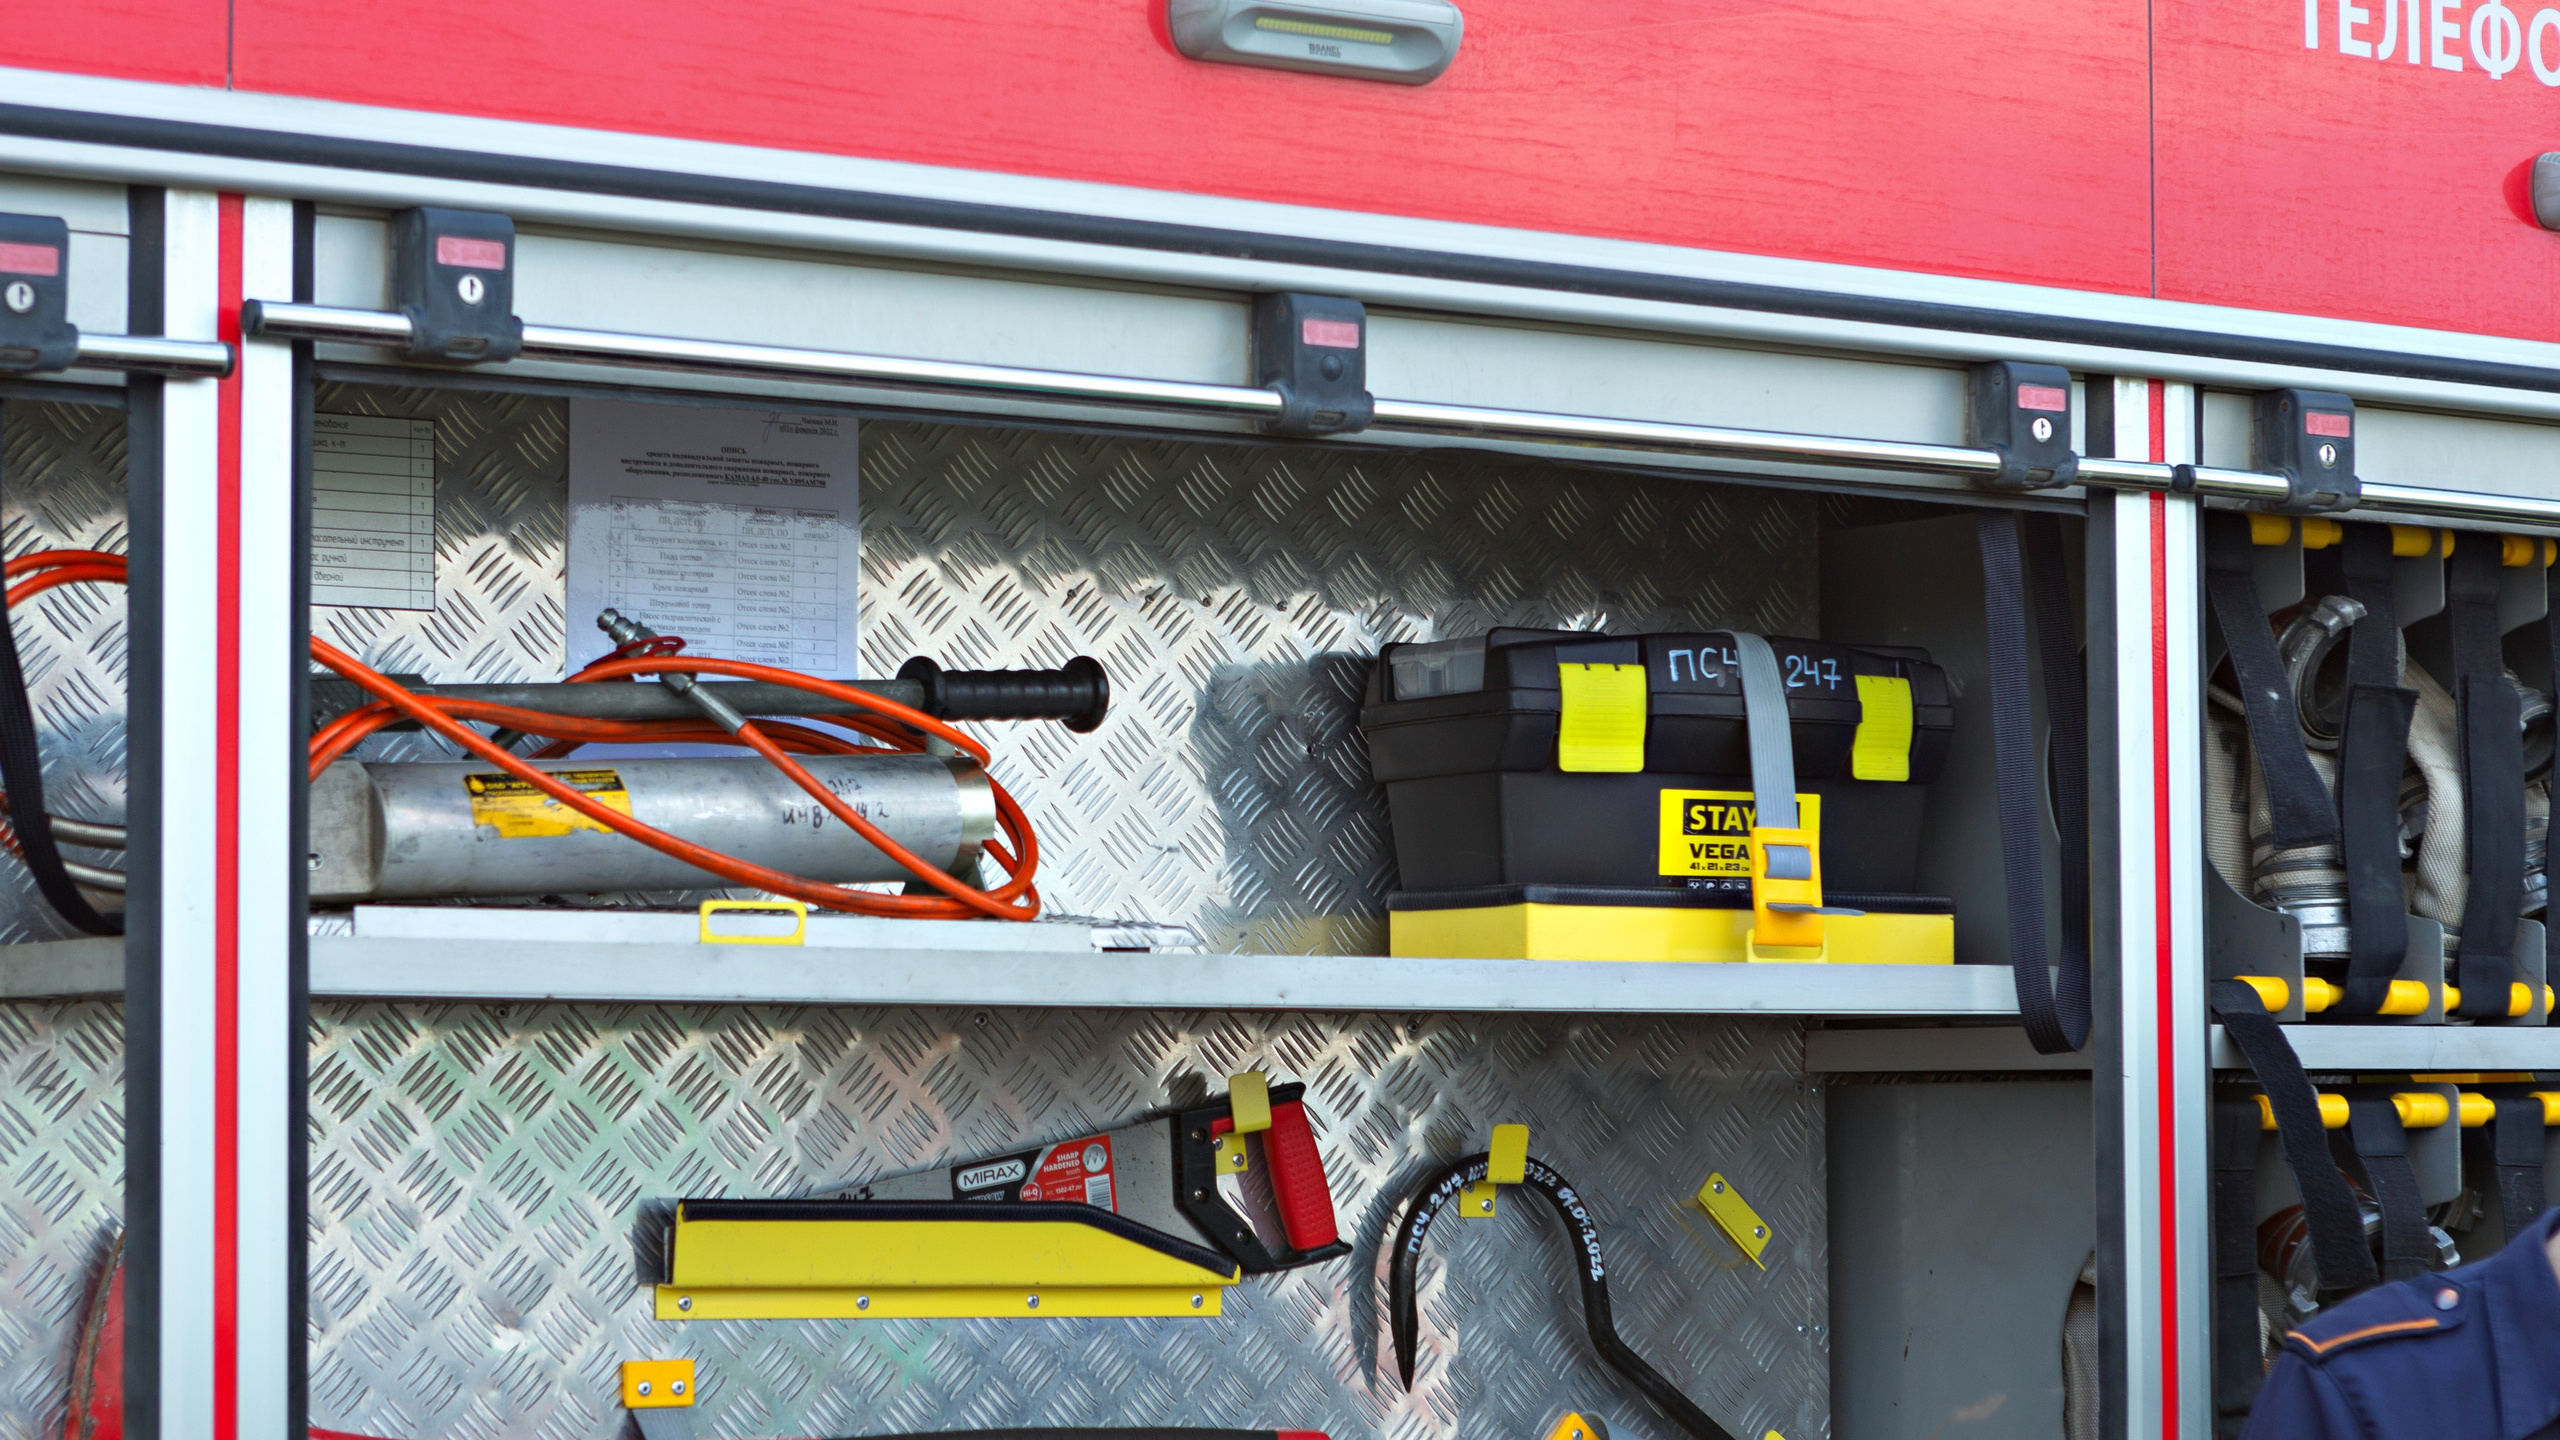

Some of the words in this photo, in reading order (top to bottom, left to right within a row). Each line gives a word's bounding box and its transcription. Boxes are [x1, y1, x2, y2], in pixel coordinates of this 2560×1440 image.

[721, 446, 747, 455] ОПИСЬ
[797, 511, 836, 519] Количество
[360, 538, 405, 548] инструмент
[634, 534, 676, 544] Инструмент
[738, 541, 759, 549] Отсек
[780, 543, 791, 551] №2
[322, 554, 347, 563] ручной
[738, 557, 759, 565] Отсек
[779, 559, 790, 567] №2
[315, 571, 344, 581] дверной
[779, 574, 790, 582] №2
[653, 583, 672, 593] Крюк
[674, 584, 709, 593] пожарный
[737, 588, 758, 596] Отсек
[779, 590, 790, 598] №2
[649, 599, 690, 608] Штурмовой
[692, 602, 712, 611] топор
[779, 606, 790, 614] №2
[640, 612, 660, 620] Насос
[662, 612, 715, 623] гидравлический
[737, 622, 757, 630] Отсек
[778, 624, 790, 632] №2
[677, 625, 711, 633] приводом
[736, 639, 757, 647] Отсек
[778, 641, 789, 649] №2
[778, 656, 789, 664] №2
[1785, 655, 1842, 690] 247
[1689, 843, 1750, 860] VEGA
[1690, 862, 1700, 871] 41
[1707, 863, 1718, 871] 21
[1725, 863, 1740, 871] 23
[1057, 1152, 1079, 1162] SHARP
[1043, 1159, 1080, 1173] HARDENED
[964, 1164, 1020, 1187] MIRAX
[1066, 1168, 1081, 1176] tooth
